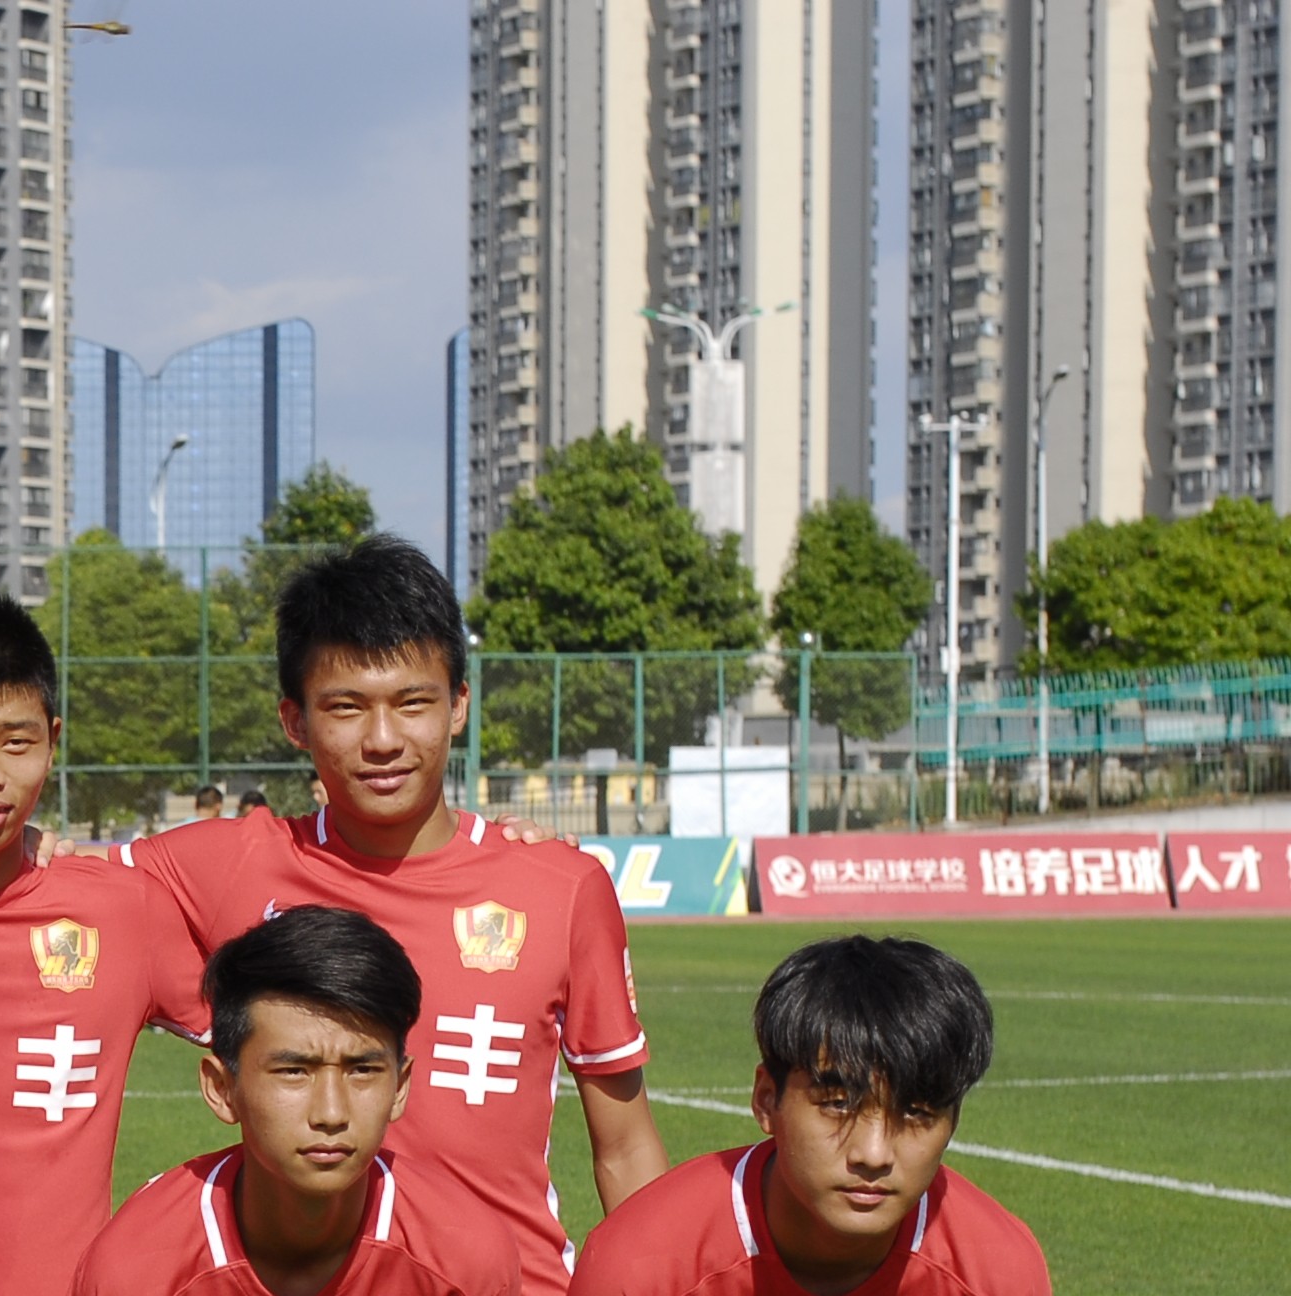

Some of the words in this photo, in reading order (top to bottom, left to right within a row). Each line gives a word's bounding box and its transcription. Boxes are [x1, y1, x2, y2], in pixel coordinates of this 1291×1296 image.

[810, 858, 968, 884] 恒大足球学校
